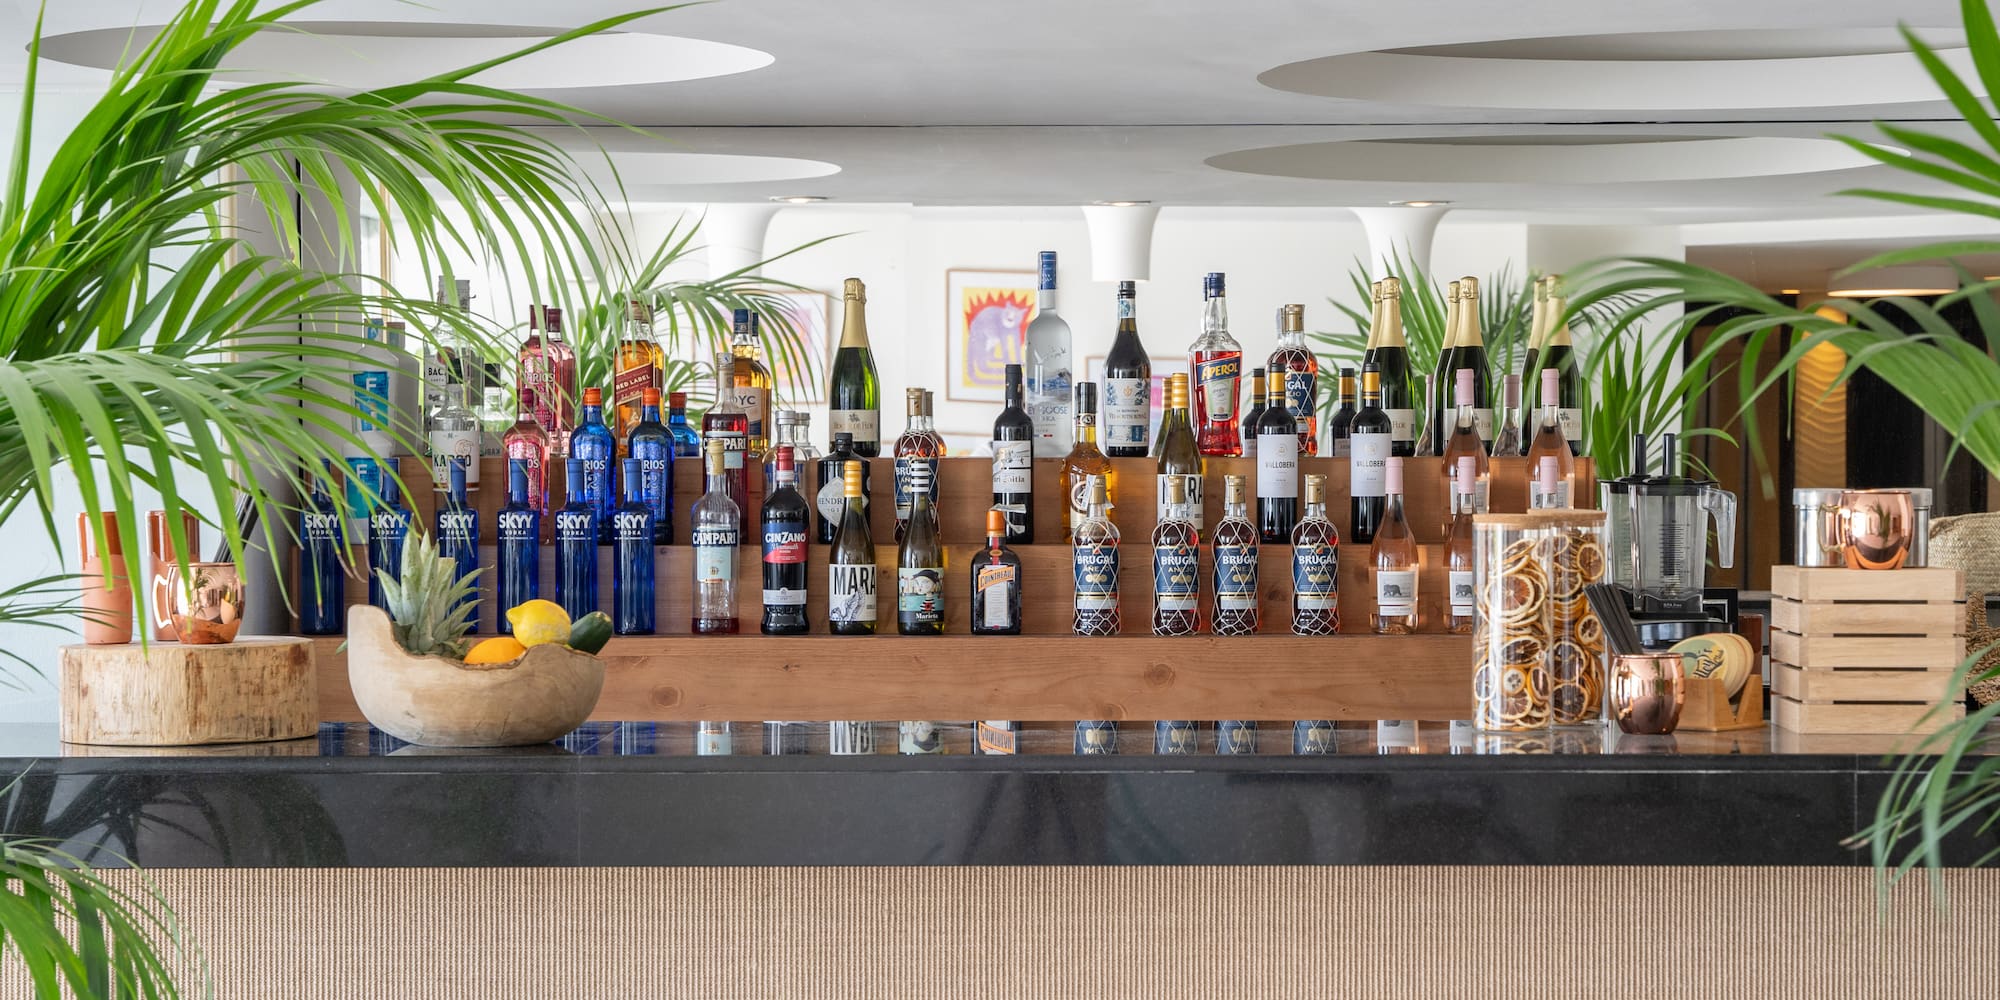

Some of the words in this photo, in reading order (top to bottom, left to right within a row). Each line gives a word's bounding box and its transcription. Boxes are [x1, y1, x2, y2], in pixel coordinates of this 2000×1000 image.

[1201, 362, 1238, 380] APEROL
[616, 381, 629, 391] RED
[630, 374, 651, 386] LABEL
[1285, 382, 1307, 390] GAL
[703, 437, 746, 450] CPARI
[584, 460, 605, 470] RIOS
[643, 460, 665, 470] RIOS
[304, 514, 340, 529] SKYY
[371, 514, 406, 529] SKYY
[439, 514, 475, 529] SKYY
[499, 514, 534, 529] SKYY
[556, 514, 592, 529] SKYY
[614, 514, 648, 529] SKYY
[692, 531, 737, 545] CAMPARI
[765, 532, 806, 544] CINZANO
[1076, 555, 1115, 565] BRUGAL
[1161, 555, 1197, 566] BRUGAL
[1298, 555, 1336, 565] BRUGAL
[980, 568, 1013, 588] COINTREAU
